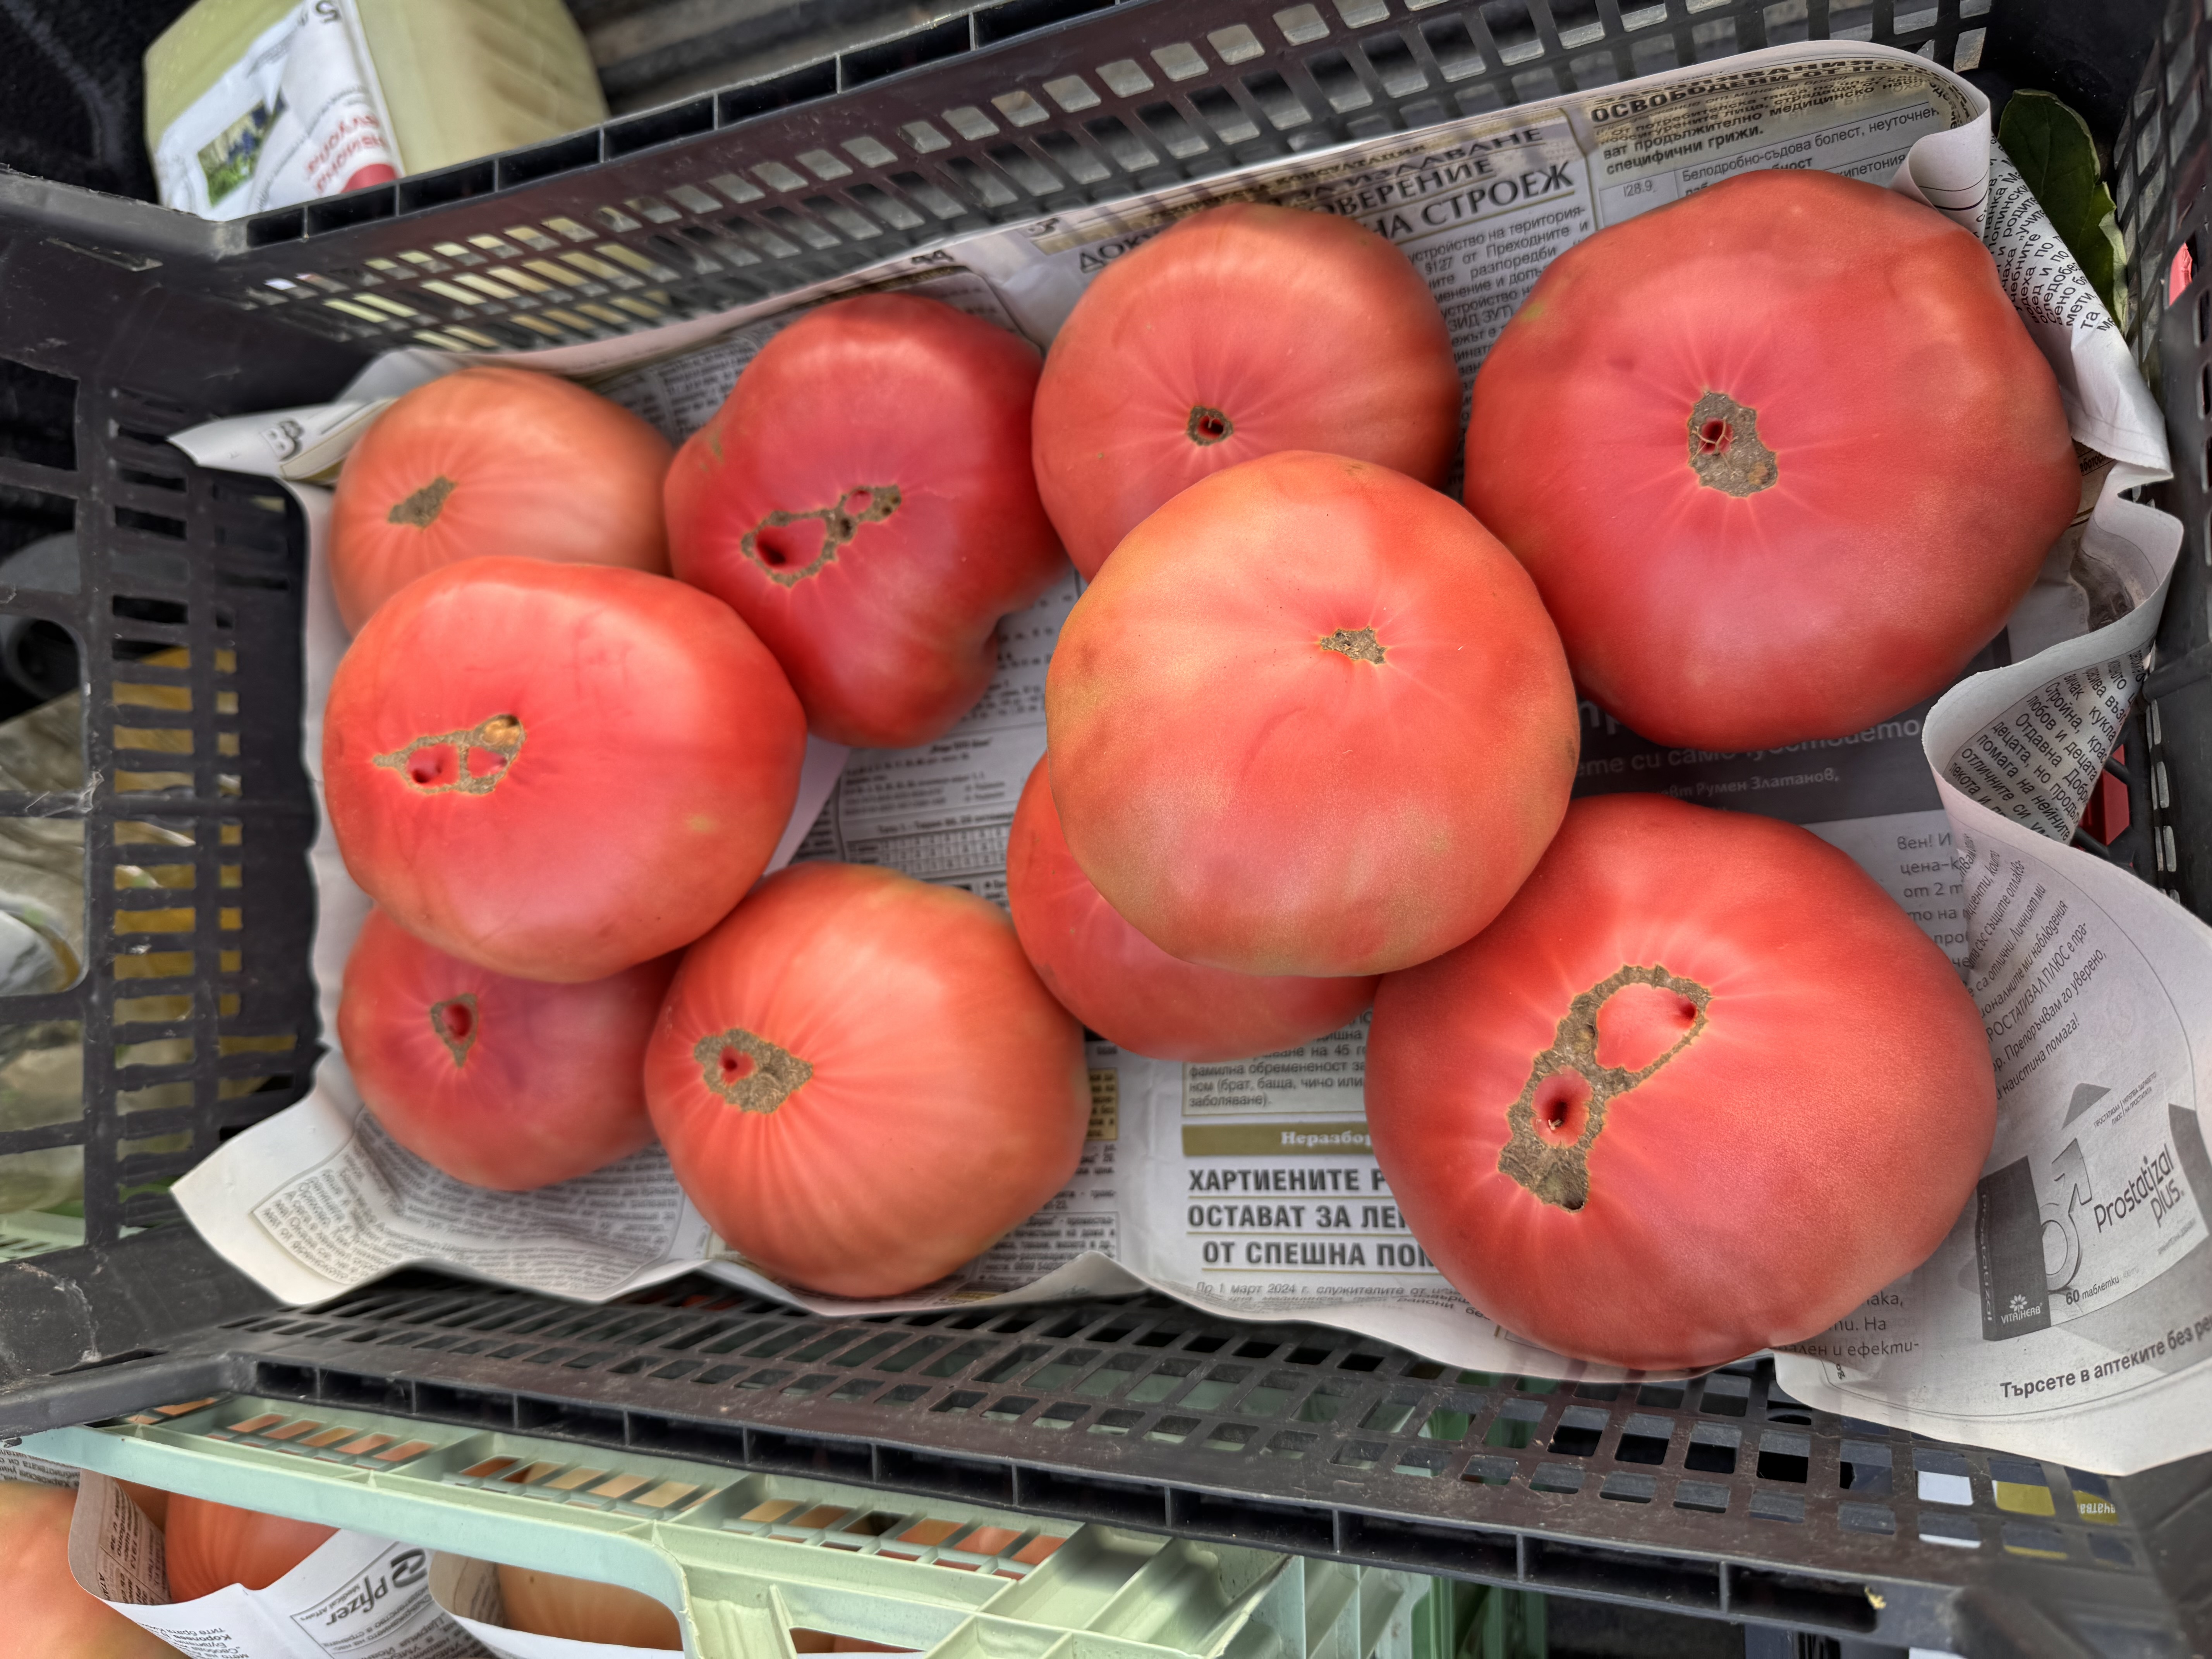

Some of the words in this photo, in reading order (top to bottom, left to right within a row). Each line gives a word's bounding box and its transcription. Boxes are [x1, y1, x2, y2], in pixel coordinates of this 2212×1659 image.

[1603, 146, 1627, 160] ват
[1634, 113, 1762, 153] продължително
[1769, 87, 1875, 117] медицинско
[1606, 139, 1702, 175] специфични
[1708, 126, 1764, 150] грижи.
[1682, 140, 1812, 182] Белодробно-съдова
[1815, 126, 1865, 147] болест,
[1420, 160, 1575, 228] СТРОЕЖ
[1462, 252, 1478, 265] от
[1486, 225, 1570, 258] Преходните
[1579, 220, 1589, 232] и
[1487, 228, 1505, 240] на
[1509, 205, 1586, 234] територия-
[1469, 245, 1557, 279] разпоредби
[2035, 241, 2054, 258] по
[2039, 267, 2052, 276] и
[2050, 250, 2069, 263] по
[2080, 310, 2100, 330] та
[2027, 695, 2056, 730] любов
[2055, 729, 2068, 740] и
[2045, 682, 2083, 734] Стройна,
[1991, 721, 2030, 768] децата,
[2034, 766, 2051, 784] но
[2016, 713, 2063, 768] Отдавна
[1697, 780, 1747, 798] Румен
[1750, 766, 1840, 790] Златанов,
[1949, 762, 1981, 795] лекота
[1961, 748, 2014, 801] отличните
[2013, 804, 2031, 818] си
[1976, 734, 2018, 778] помага
[2017, 778, 2035, 794] на
[2031, 795, 2071, 841] нейните
[1903, 886, 1930, 898] от
[1933, 882, 1944, 896] 2
[1937, 909, 1957, 920] на
[1983, 894, 2011, 936] същите
[1976, 977, 1989, 992] са
[2009, 896, 2039, 943] Личният
[2033, 883, 2046, 901] ми
[2022, 955, 2034, 974] ми
[2032, 900, 2068, 959] наблюдения
[1985, 976, 2048, 1042] РОСТАТИЗАЛ
[2041, 945, 2070, 984] ПЛЮС
[2067, 941, 2075, 953] е
[2072, 922, 2087, 949] пра-
[2004, 999, 2063, 1061] Препоръчвам
[2061, 990, 2073, 1004] го
[2070, 949, 2107, 996] уверено,
[1188, 1063, 1245, 1080] фамилна
[1248, 1061, 1348, 1076] обремененост
[1334, 1044, 1350, 1056] 45
[2002, 1049, 2047, 1096] наистина
[2044, 1012, 2080, 1056] помага!
[1338, 1077, 1363, 1087] или
[1188, 1168, 1360, 1192] ХАРТИЕНИТЕ
[2094, 1143, 2174, 1233] Prostatizal
[1188, 1204, 1306, 1228] ОСТАВАТ
[1316, 1205, 1352, 1228] ЗА
[1202, 1241, 1236, 1264] ОТ
[1245, 1242, 1366, 1266] СПЕШНА
[1230, 1285, 1262, 1295] март
[1267, 1283, 1296, 1294] 2024
[2065, 1289, 2081, 1305] 60
[2081, 1274, 2120, 1300] таблетки
[1864, 1316, 1886, 1331] На
[1833, 1347, 1841, 1356] и
[1847, 1340, 1919, 1358] ефекти-
[1999, 1371, 2076, 1399] Търсете
[2080, 1369, 2090, 1383] в
[2094, 1341, 2166, 1379] аптеките
[2167, 1329, 2194, 1350] без
[326, 1575, 389, 1626] Pfizer
